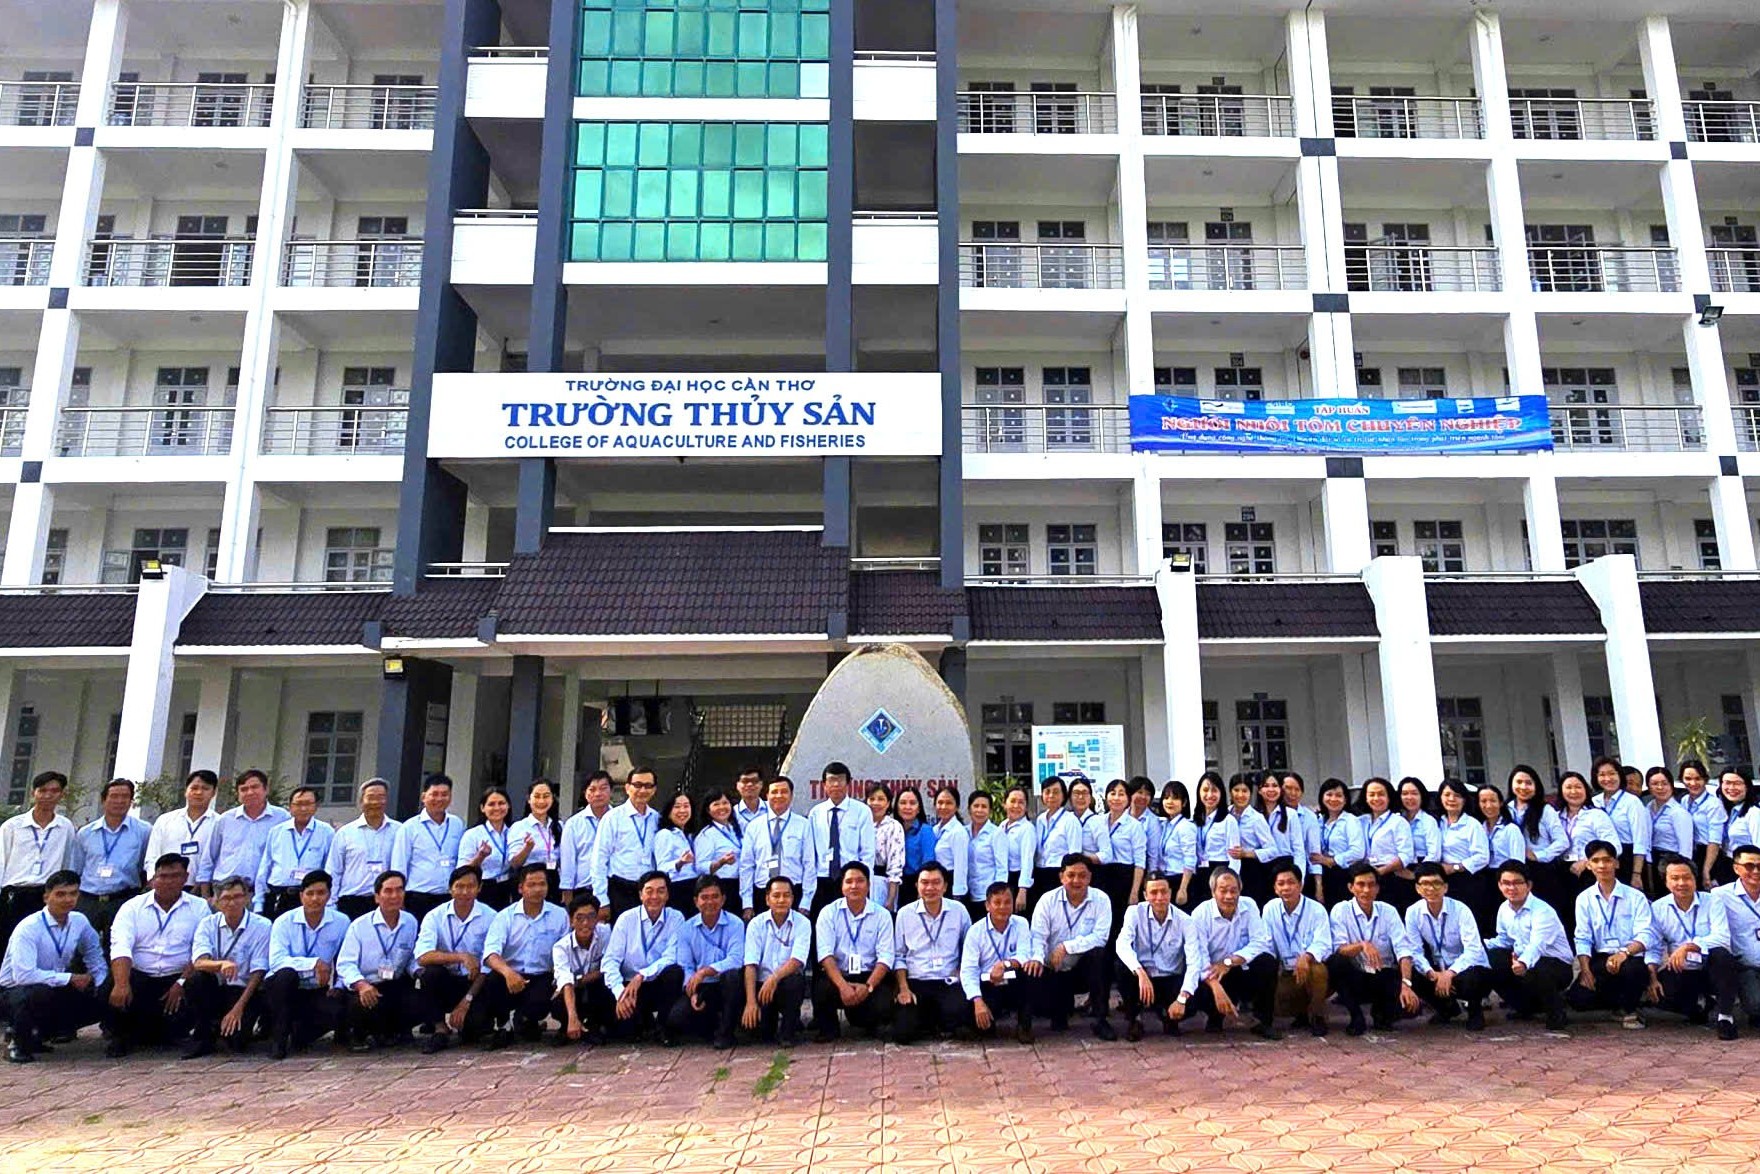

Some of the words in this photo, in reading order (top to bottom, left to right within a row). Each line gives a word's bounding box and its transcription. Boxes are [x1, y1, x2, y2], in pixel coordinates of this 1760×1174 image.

[565, 377, 645, 391] TRƯỜNG
[651, 379, 681, 394] ĐẠI
[686, 380, 726, 394] HỌC
[731, 376, 770, 391] CẦN
[776, 379, 816, 391] THƠ
[501, 394, 673, 427] TRƯỜNG
[683, 393, 794, 427] THỦY
[802, 393, 876, 426] SẢN
[1294, 417, 1341, 433] TÔM
[1347, 416, 1435, 431] CHUYÊN
[1441, 415, 1521, 432] NGHIỆP
[504, 435, 582, 449] COLLEGE
[587, 435, 609, 448] OF
[613, 434, 737, 449] AQUACULTURE
[741, 434, 775, 448] AND
[781, 434, 865, 448] FISHERIES
